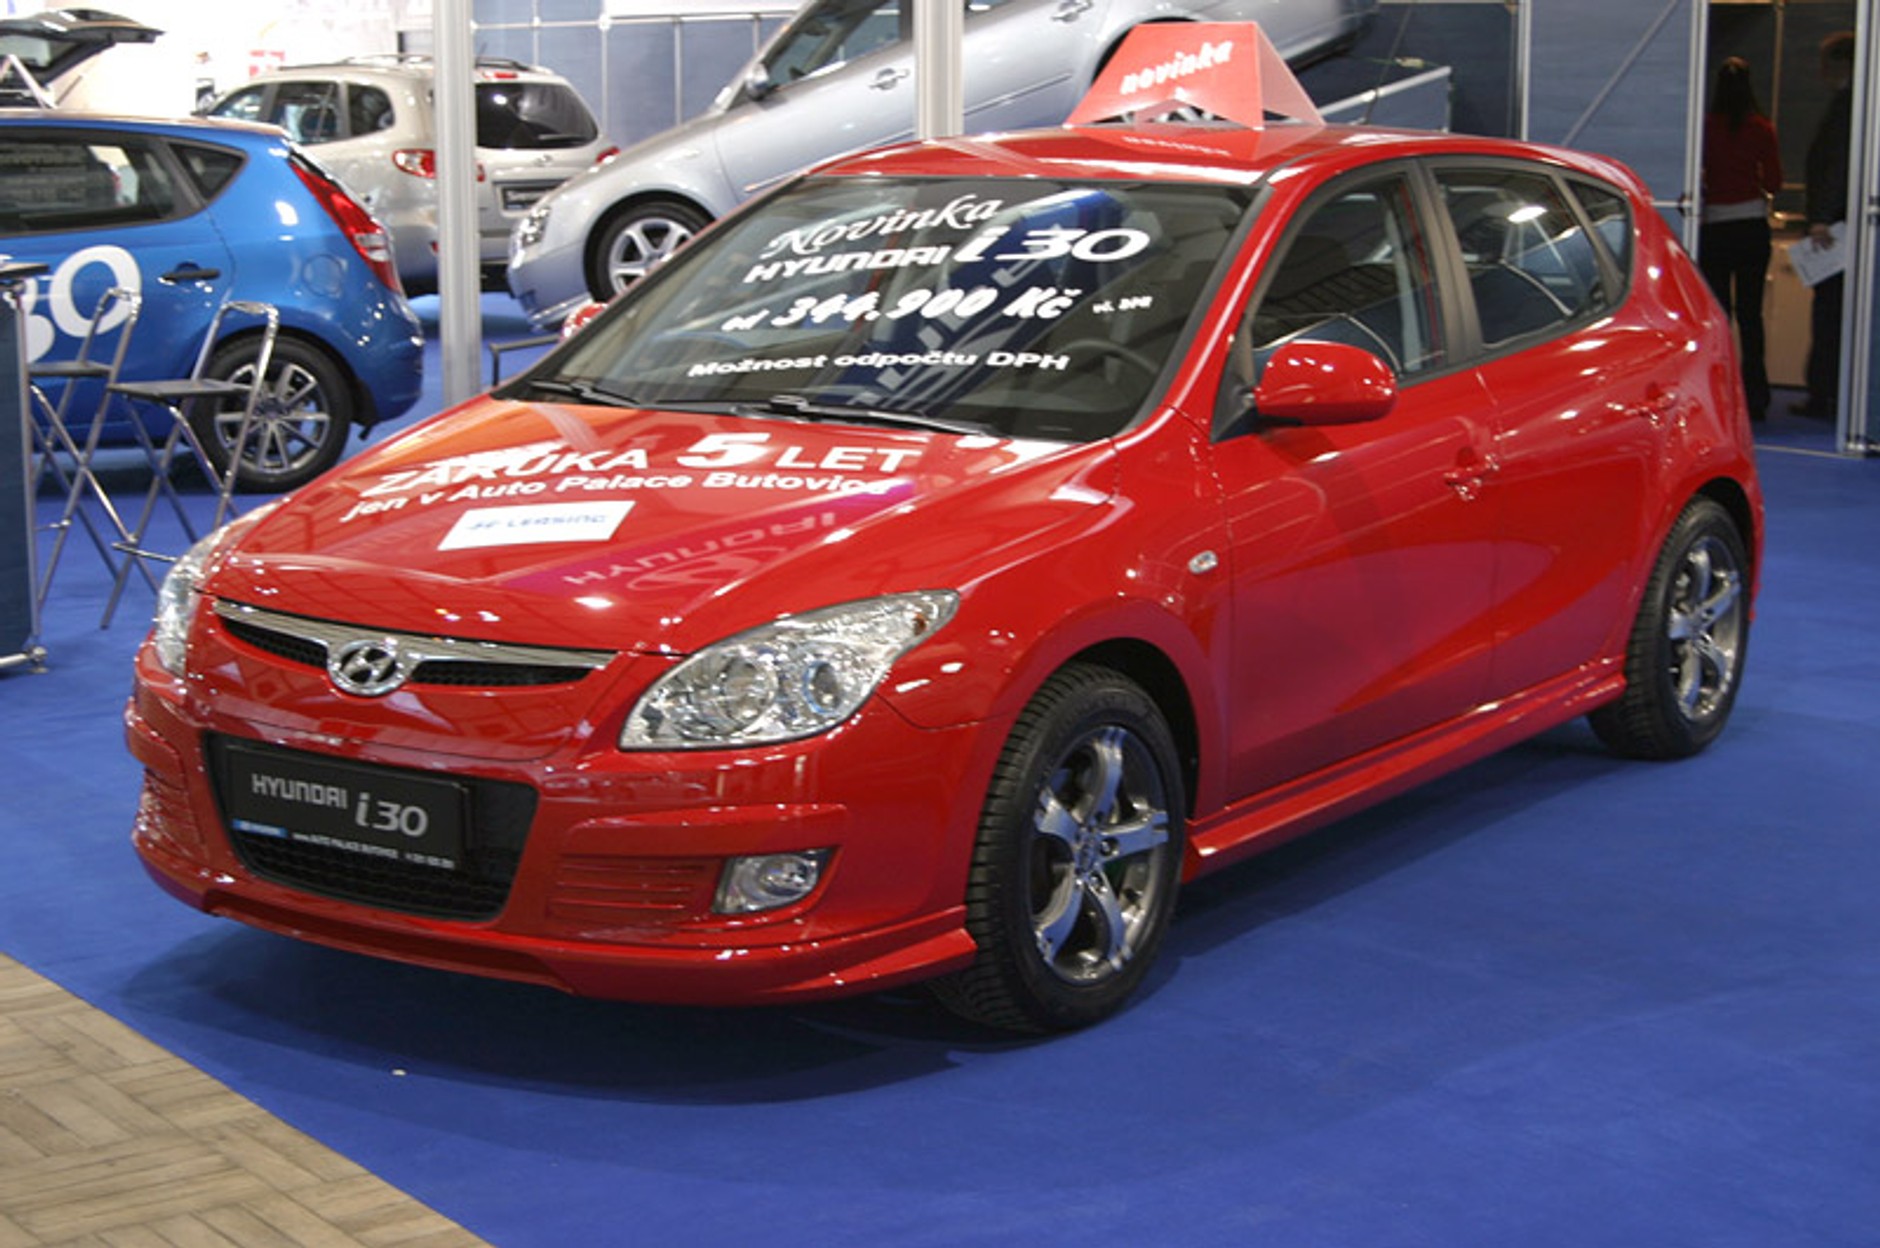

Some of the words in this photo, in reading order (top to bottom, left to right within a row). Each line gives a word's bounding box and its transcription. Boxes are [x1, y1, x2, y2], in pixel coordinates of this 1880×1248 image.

[1119, 40, 1234, 95] novinka
[759, 193, 1004, 255] Novinka
[743, 245, 952, 283] HYUNDAI
[1001, 285, 1083, 320] Kč
[687, 355, 829, 378] Možnost
[834, 350, 978, 369] odpočtu
[986, 351, 1071, 371] DPH
[676, 432, 771, 468] 5
[775, 446, 923, 473] LET
[341, 496, 408, 523] jen
[420, 491, 445, 505] v
[447, 480, 547, 502] Auto
[555, 473, 693, 493] Palace
[252, 773, 348, 810] HYUNDAI
[355, 792, 429, 838] i30
